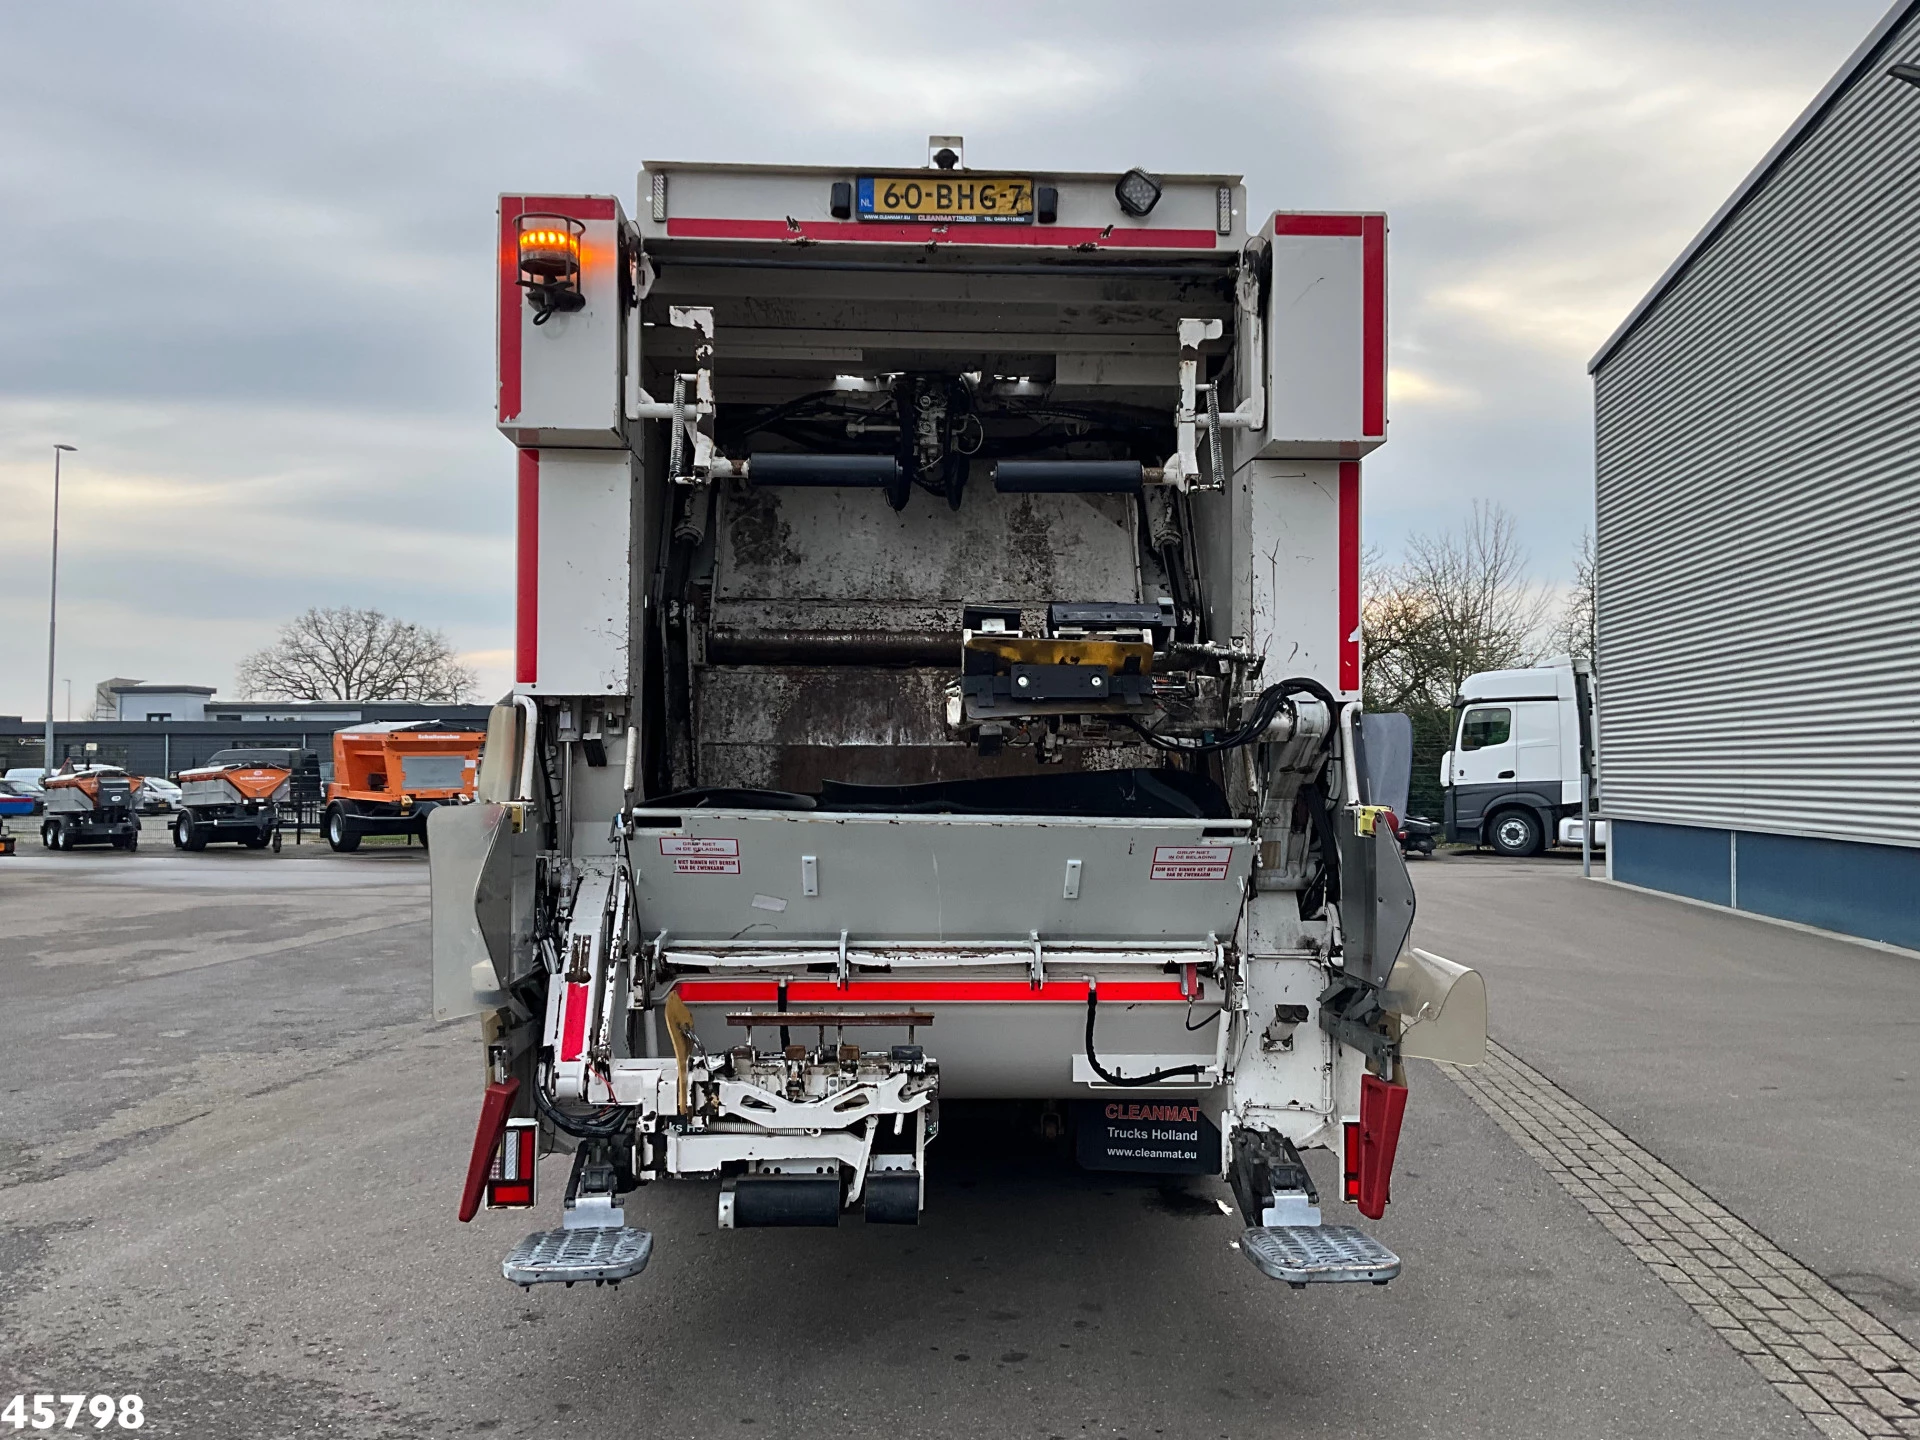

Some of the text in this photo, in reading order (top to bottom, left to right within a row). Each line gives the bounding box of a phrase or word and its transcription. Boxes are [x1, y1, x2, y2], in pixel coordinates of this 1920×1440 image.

[860, 199, 873, 208] NL
[883, 182, 1025, 210] 60-BHG-7
[1105, 1103, 1201, 1122] CLEANMAT
[1107, 1126, 1198, 1141] Trucks Holland
[1107, 1148, 1197, 1159] www.cleanmat.eu
